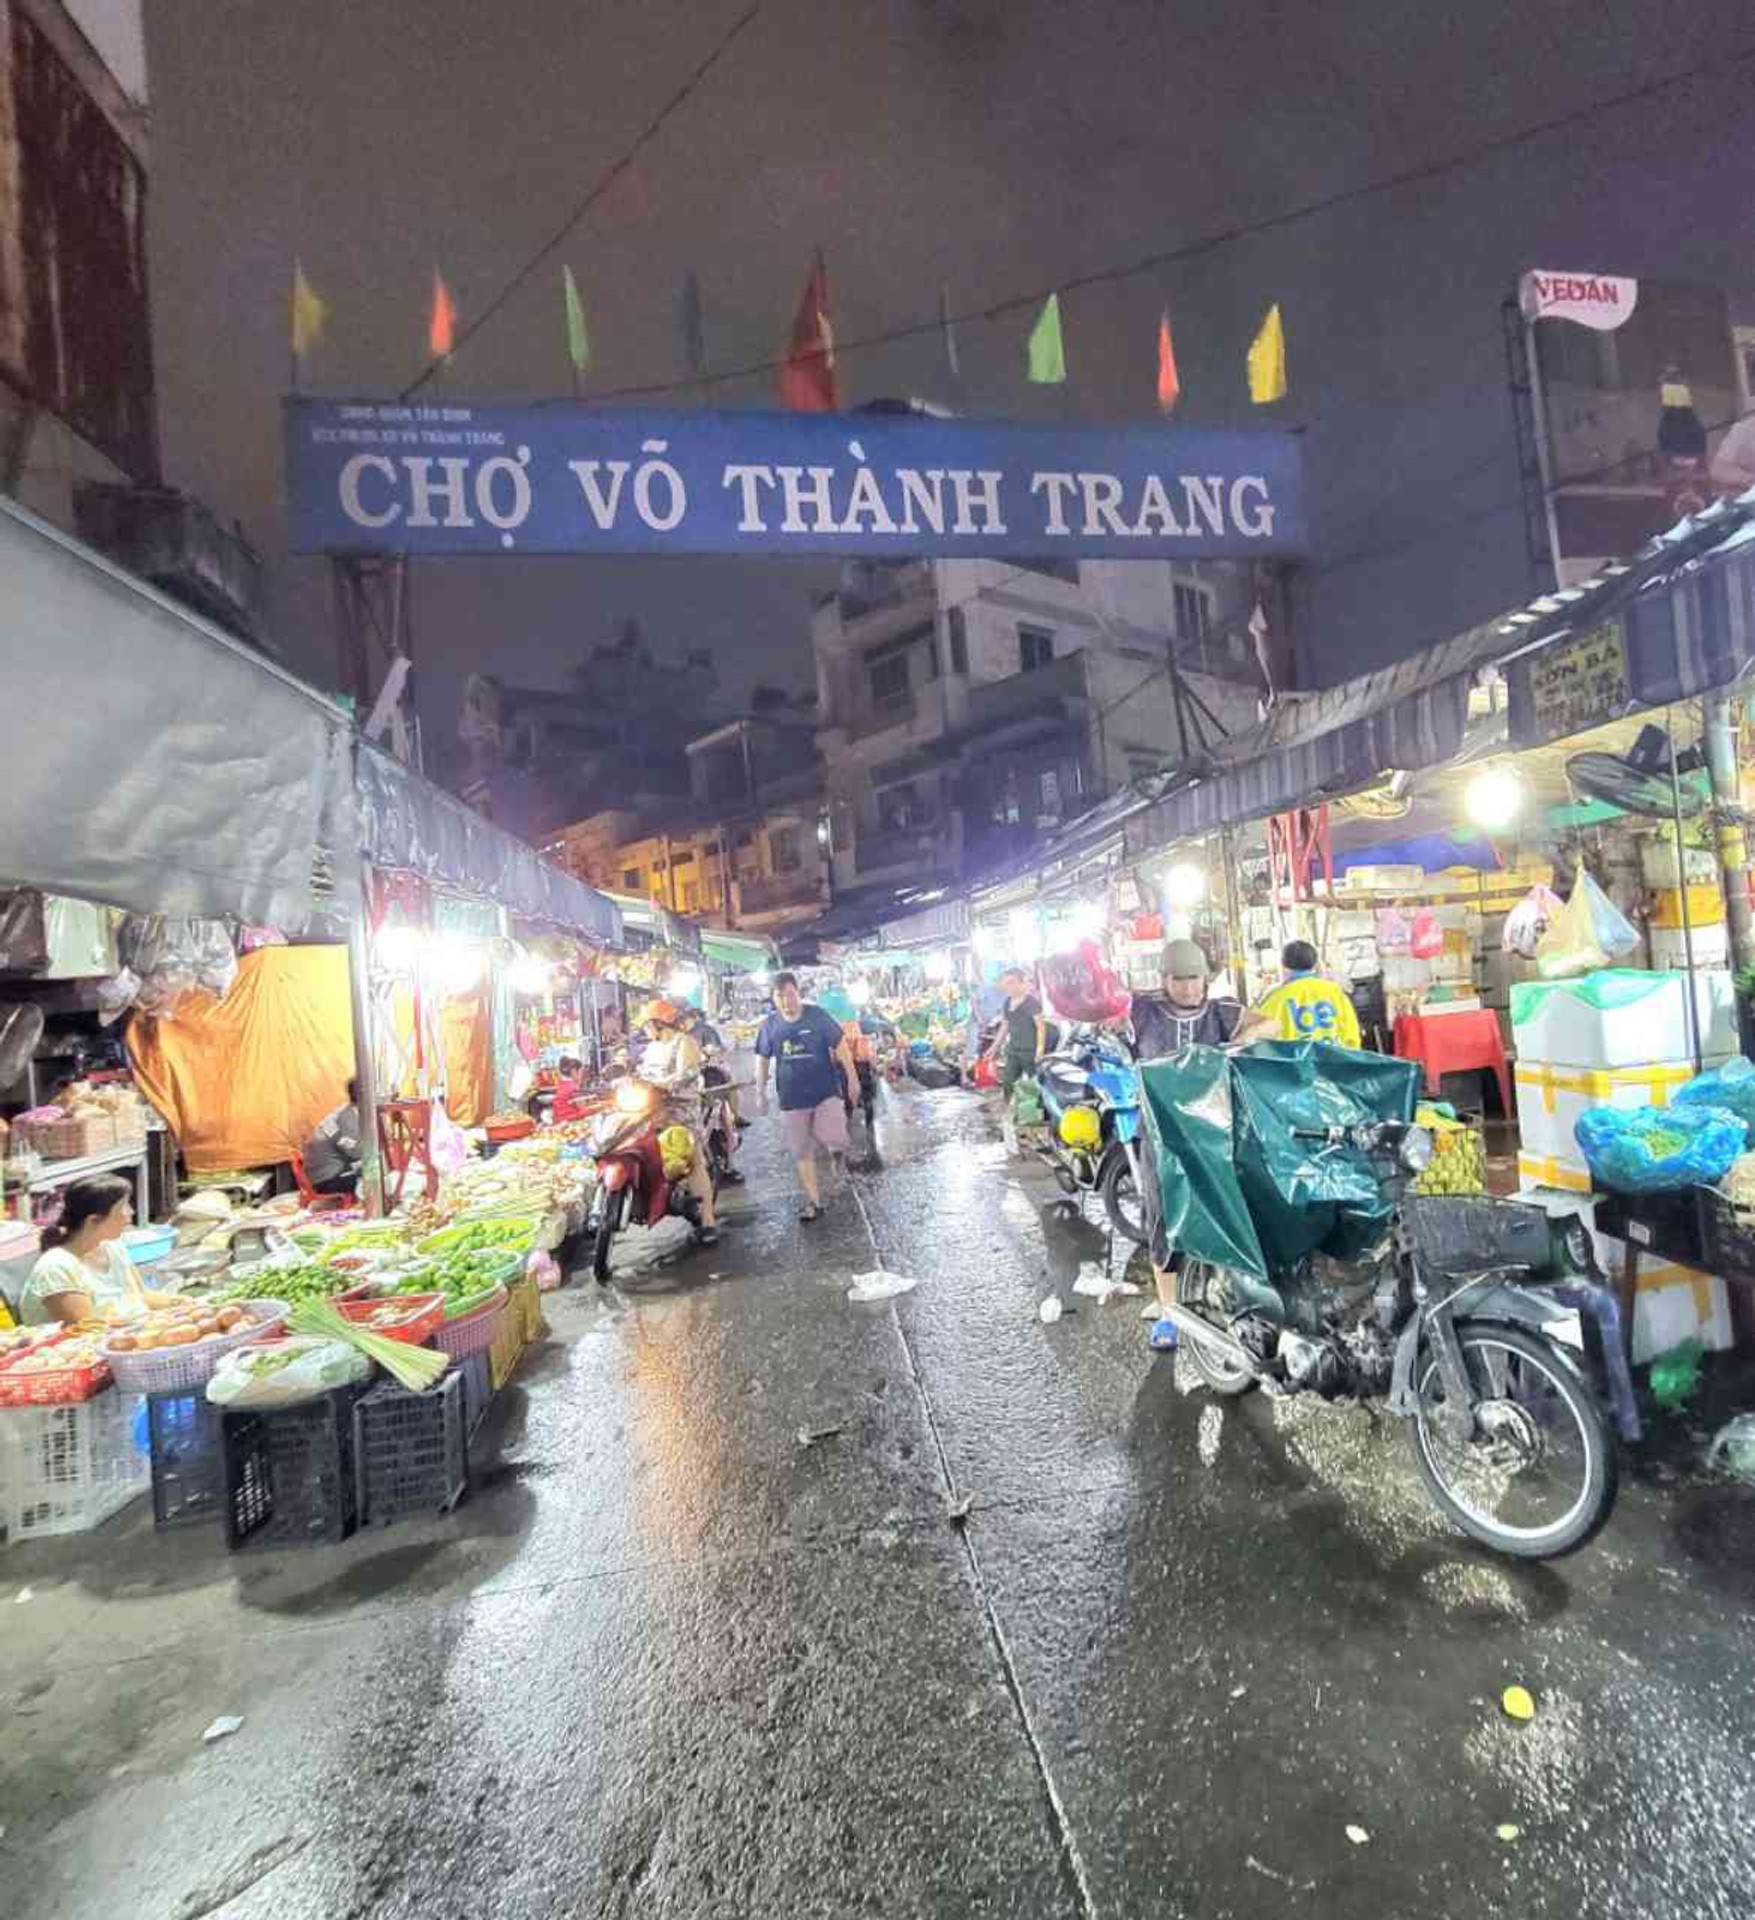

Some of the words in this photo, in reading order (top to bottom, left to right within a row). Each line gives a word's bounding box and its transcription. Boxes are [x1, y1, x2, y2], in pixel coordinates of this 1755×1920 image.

[1535, 277, 1619, 305] VEDAN
[339, 445, 533, 549] CHỢ
[568, 438, 688, 532] VÕ
[722, 439, 1007, 536] THÀNH
[1031, 471, 1276, 538] TRANG
